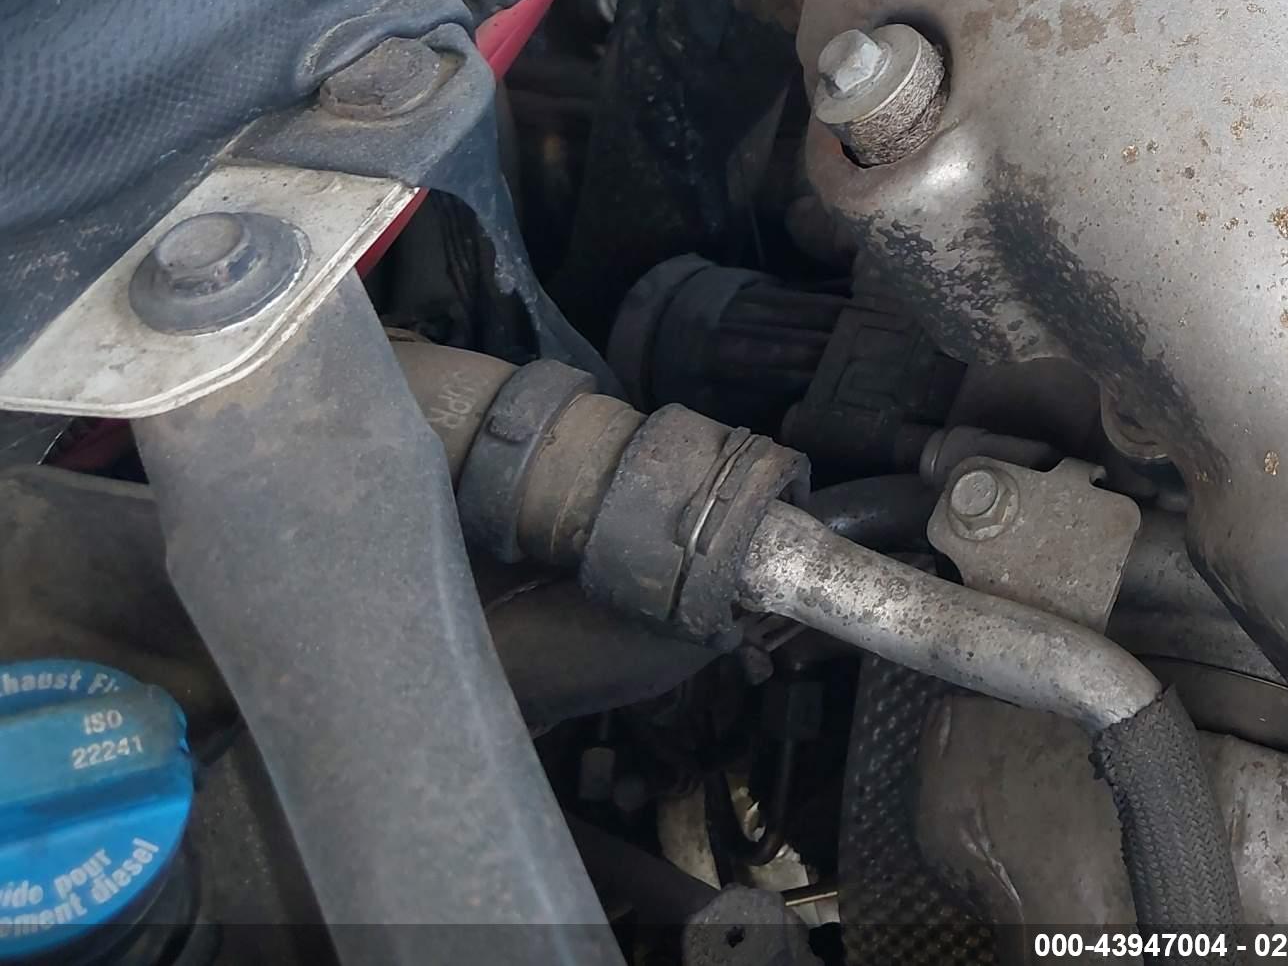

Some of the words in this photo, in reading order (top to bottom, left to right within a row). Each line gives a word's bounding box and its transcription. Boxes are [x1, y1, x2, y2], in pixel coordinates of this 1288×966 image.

[0, 670, 82, 697] haust
[84, 709, 123, 735] ISO
[71, 735, 144, 770] 22241
[54, 848, 112, 899] pour
[91, 837, 160, 904] diesel
